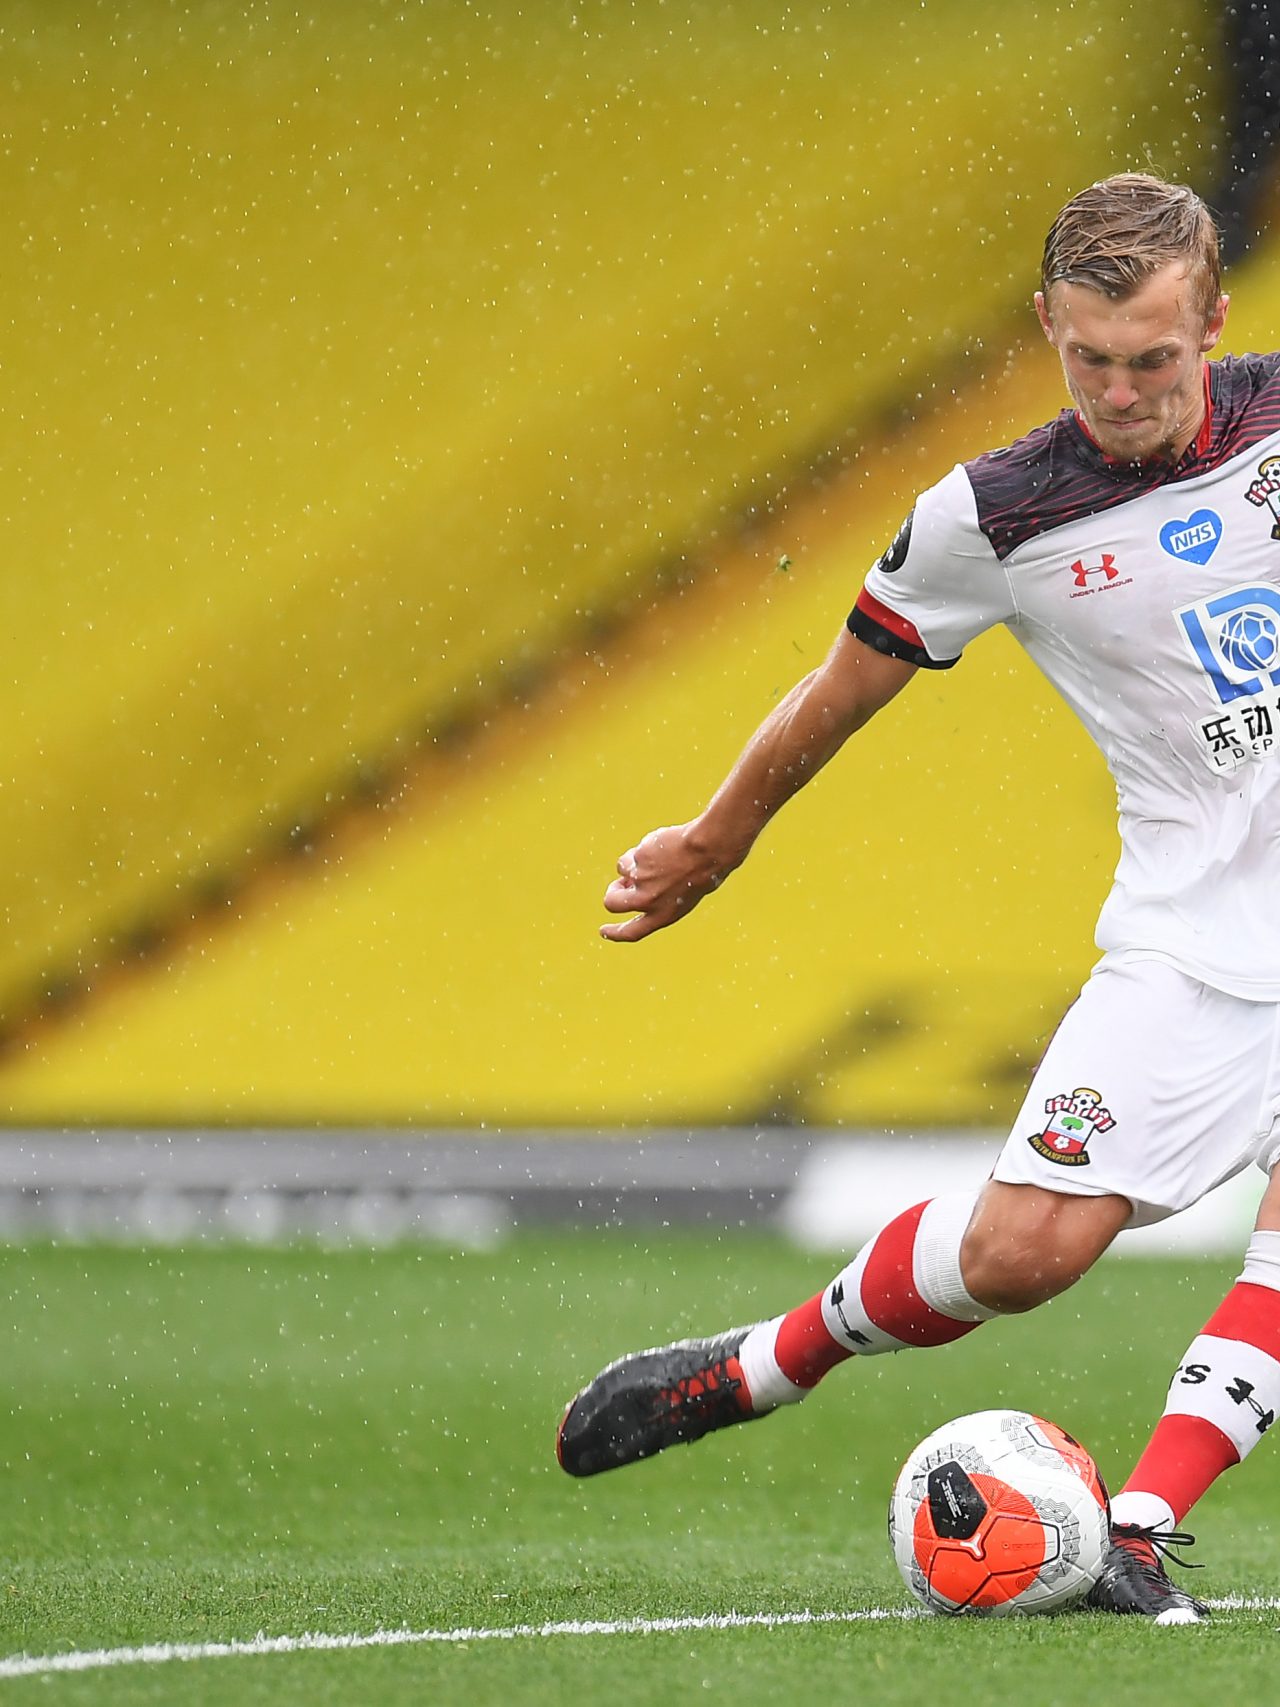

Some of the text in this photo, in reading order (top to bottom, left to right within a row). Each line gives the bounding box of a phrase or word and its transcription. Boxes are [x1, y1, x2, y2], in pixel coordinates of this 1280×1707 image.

[1175, 525, 1212, 550] NHS
[1069, 577, 1133, 599] UNDER ARMOUR
